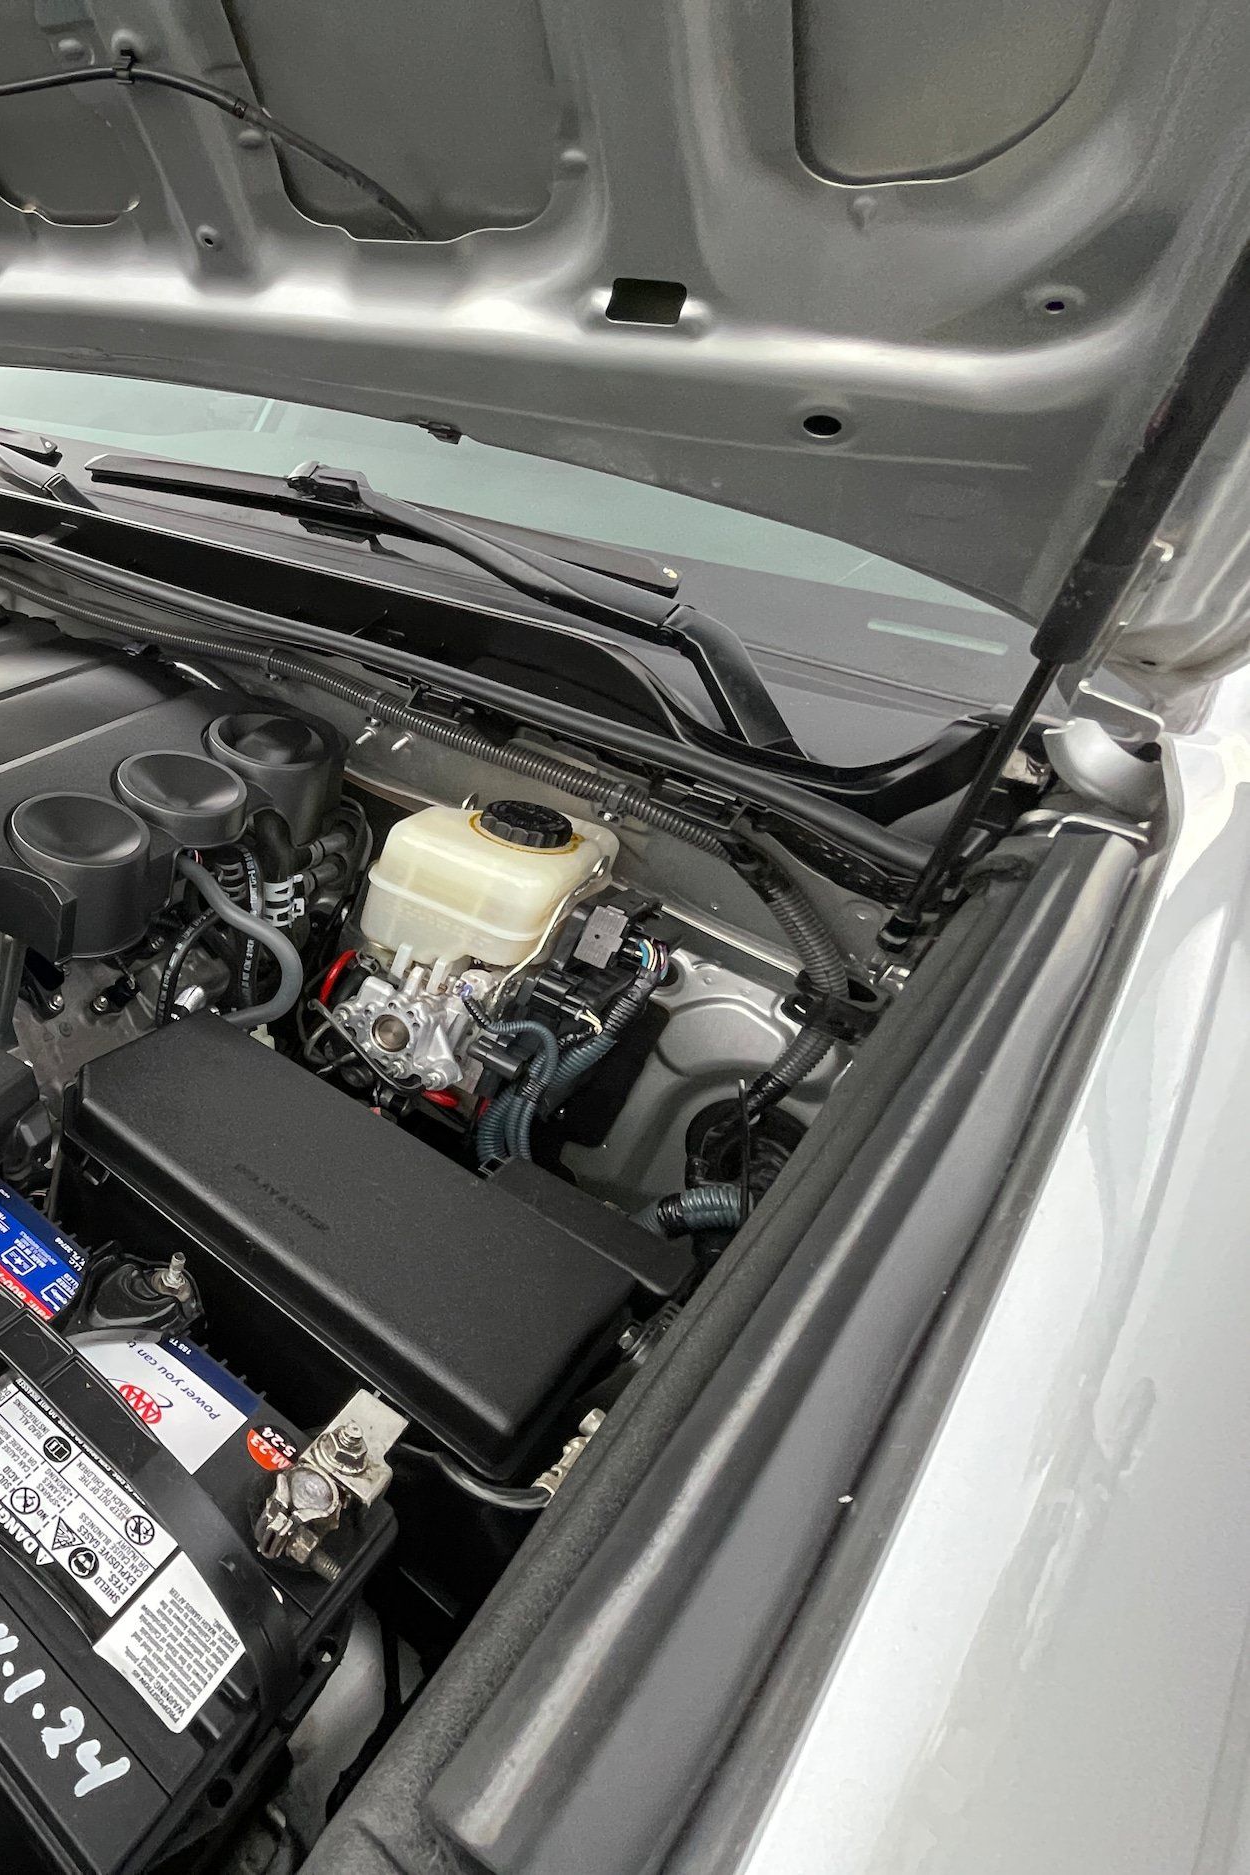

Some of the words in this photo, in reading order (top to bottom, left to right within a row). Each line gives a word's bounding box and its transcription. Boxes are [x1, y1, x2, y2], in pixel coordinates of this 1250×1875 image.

[70, 1251, 81, 1260] FL
[136, 1347, 157, 1366] can
[156, 1364, 183, 1388] you
[179, 1384, 220, 1420] Power
[11, 1397, 49, 1435] INSTRUCTIONS.
[18, 1413, 31, 1426] ALL
[27, 1423, 44, 1440] READ
[1, 1443, 20, 1462] CAUSE
[7, 1437, 27, 1457] SEVERE
[16, 1459, 31, 1473] CAN
[24, 1454, 37, 1467] OR
[1, 1465, 20, 1483] ACID
[43, 1467, 71, 1494] SMOKING
[73, 1457, 106, 1489] CHILDREN.
[77, 1473, 92, 1487] THE
[35, 1482, 59, 1505] SPARKS
[41, 1476, 65, 1500] FLAMES
[87, 1482, 100, 1495] OF
[101, 1485, 116, 1499] OF
[96, 1491, 112, 1507] OUT
[110, 1495, 132, 1515] REACH
[35, 1508, 49, 1521] NO
[108, 1503, 126, 1521] KEEP
[76, 1524, 100, 1548] GASES
[77, 1511, 112, 1545] BLINDNESS
[108, 1542, 131, 1565] CAUSE
[96, 1545, 137, 1585] EXPLOSIVE
[127, 1562, 143, 1578] CAN
[136, 1559, 149, 1572] OR
[92, 1575, 121, 1604] SHIELD
[104, 1570, 129, 1594] EYES.
[168, 1587, 186, 1605] AFTER
[183, 1602, 202, 1621] HANDS
[137, 1614, 161, 1639] California
[187, 1617, 211, 1642] California
[200, 1619, 217, 1637] WASH
[136, 1661, 155, 1682] Battery
[137, 1676, 180, 1723] PROPOSITION
[151, 1679, 186, 1716] WARNING:
